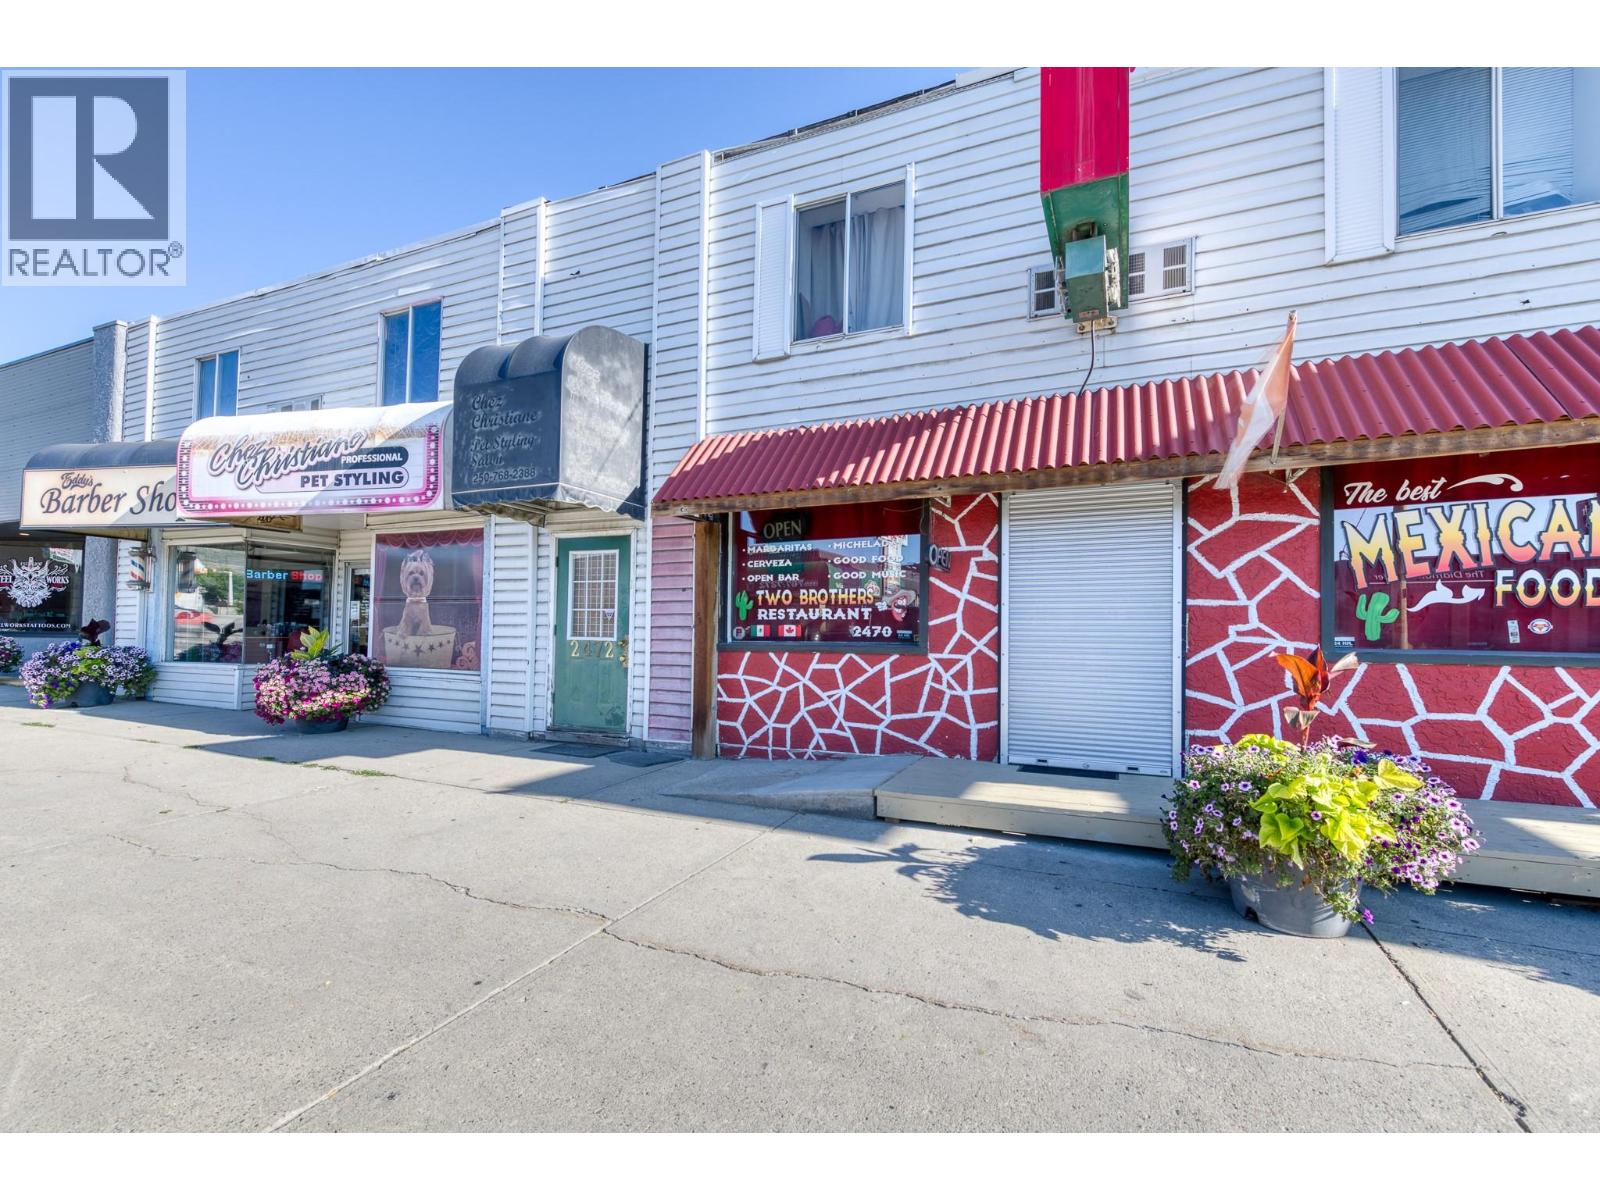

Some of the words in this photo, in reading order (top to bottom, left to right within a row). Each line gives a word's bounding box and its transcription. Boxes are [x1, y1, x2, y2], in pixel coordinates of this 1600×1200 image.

[471, 393, 504, 411] Chez
[471, 410, 538, 430] Christiane
[492, 434, 536, 450] Styling
[209, 435, 268, 474] Chez
[236, 430, 366, 486] Christiane
[341, 452, 403, 464] PROFESSIONAL
[300, 474, 327, 488] PET
[334, 470, 404, 487] STYLING
[40, 482, 127, 514] Barber
[1343, 481, 1388, 505] The
[1395, 477, 1447, 502] best
[763, 520, 802, 539] OPEN
[747, 543, 813, 554] MARGARITAS
[747, 559, 792, 568] CERVEZA
[833, 556, 867, 565] GOOD
[46, 576, 70, 584] WORKS
[247, 569, 288, 580] Barber
[290, 570, 323, 580] Shop
[747, 574, 774, 582] OPEN
[778, 573, 800, 581] BAR
[833, 571, 867, 580] GOOD
[871, 570, 907, 579] MUSIC
[756, 590, 793, 606] TWO
[799, 588, 875, 605] BROTHERS
[757, 607, 872, 621] RESTAURANT
[852, 626, 893, 638] 2470
[570, 640, 614, 658] 2472
